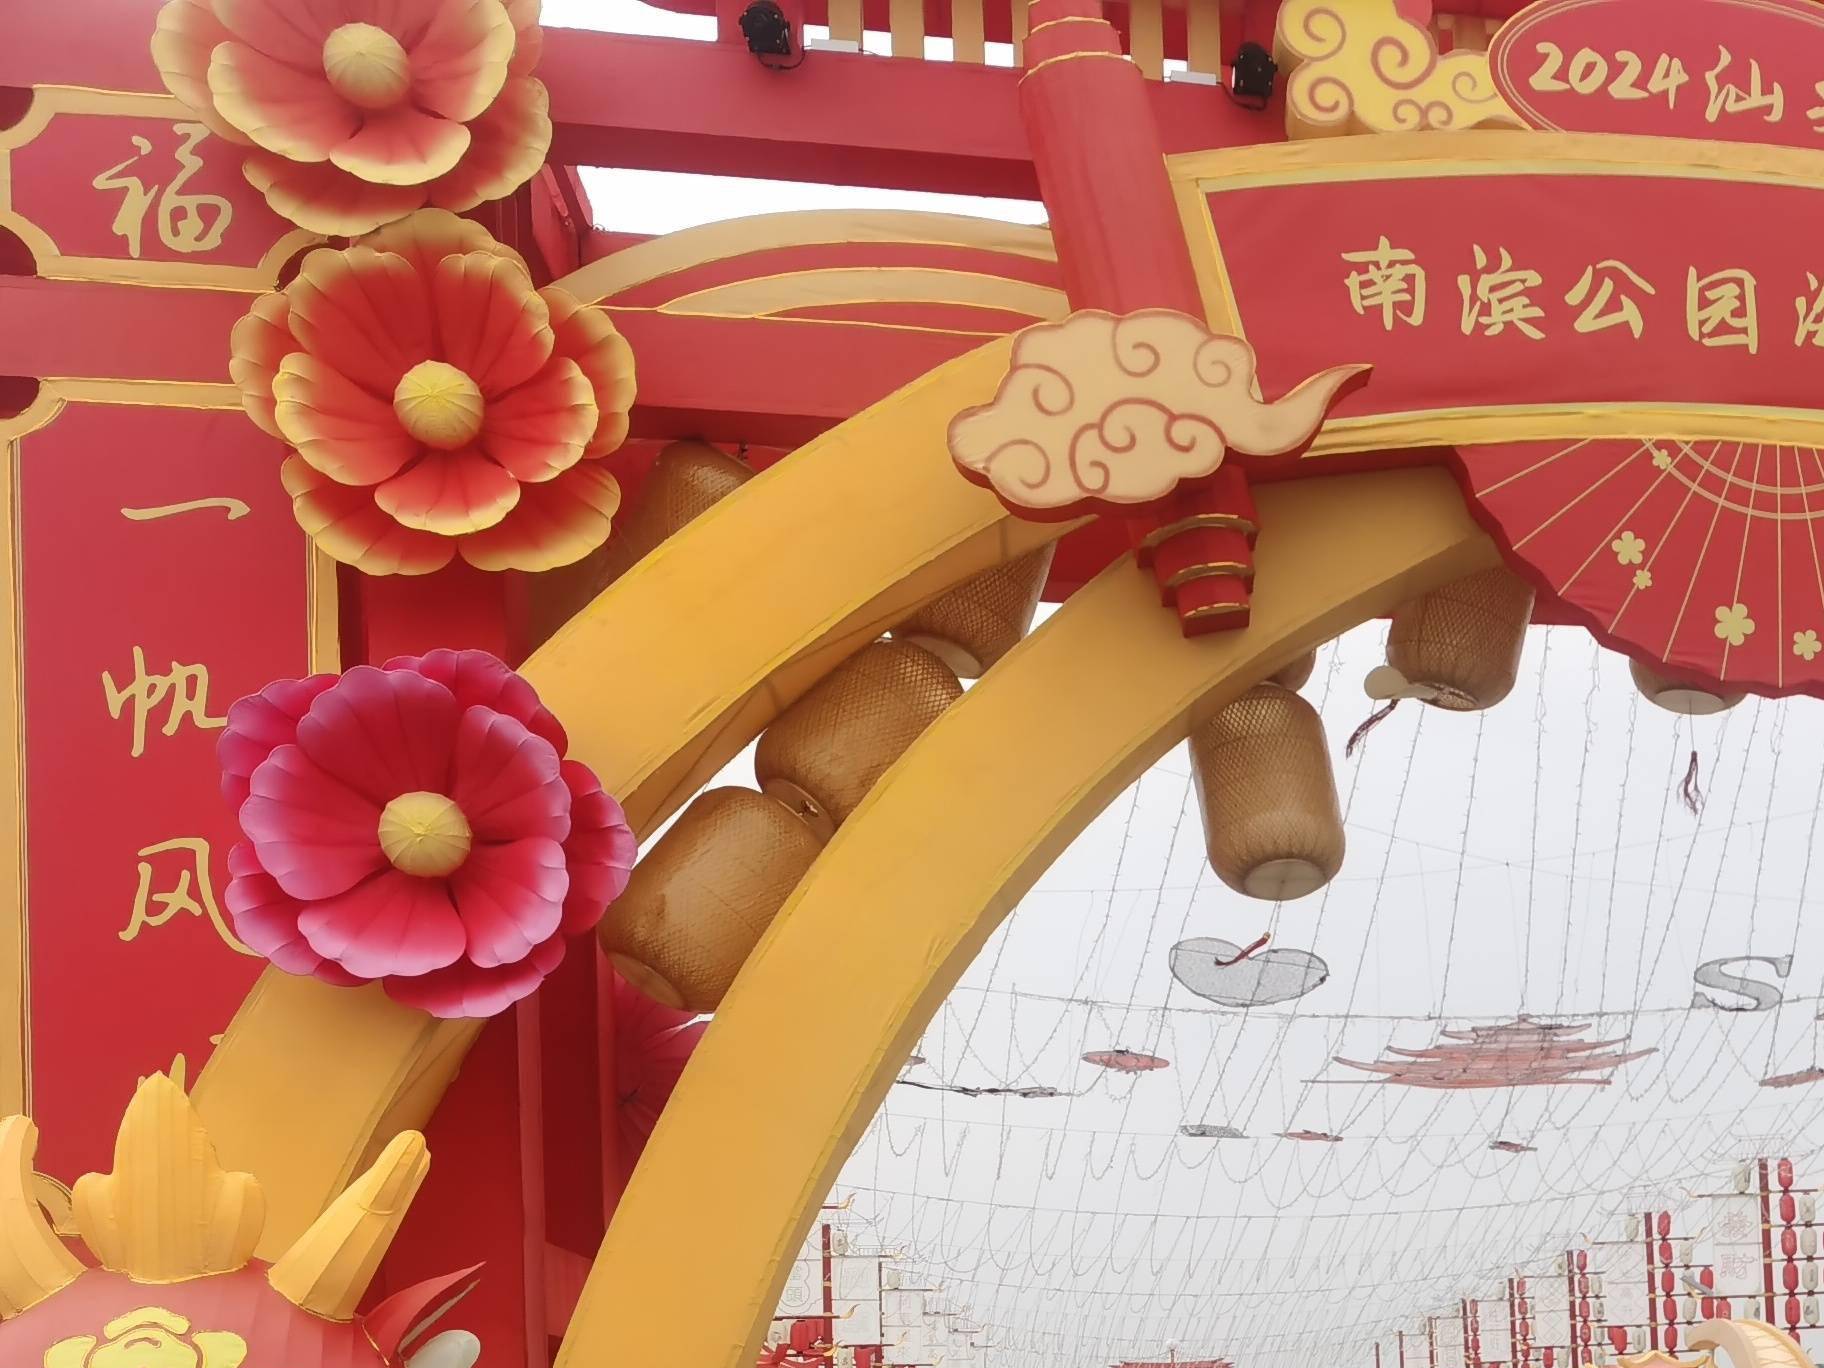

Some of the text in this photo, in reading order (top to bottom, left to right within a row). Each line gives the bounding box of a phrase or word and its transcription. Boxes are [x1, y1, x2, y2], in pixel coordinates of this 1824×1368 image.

[92, 122, 233, 259] 福
[101, 496, 265, 1091] 一帆风
